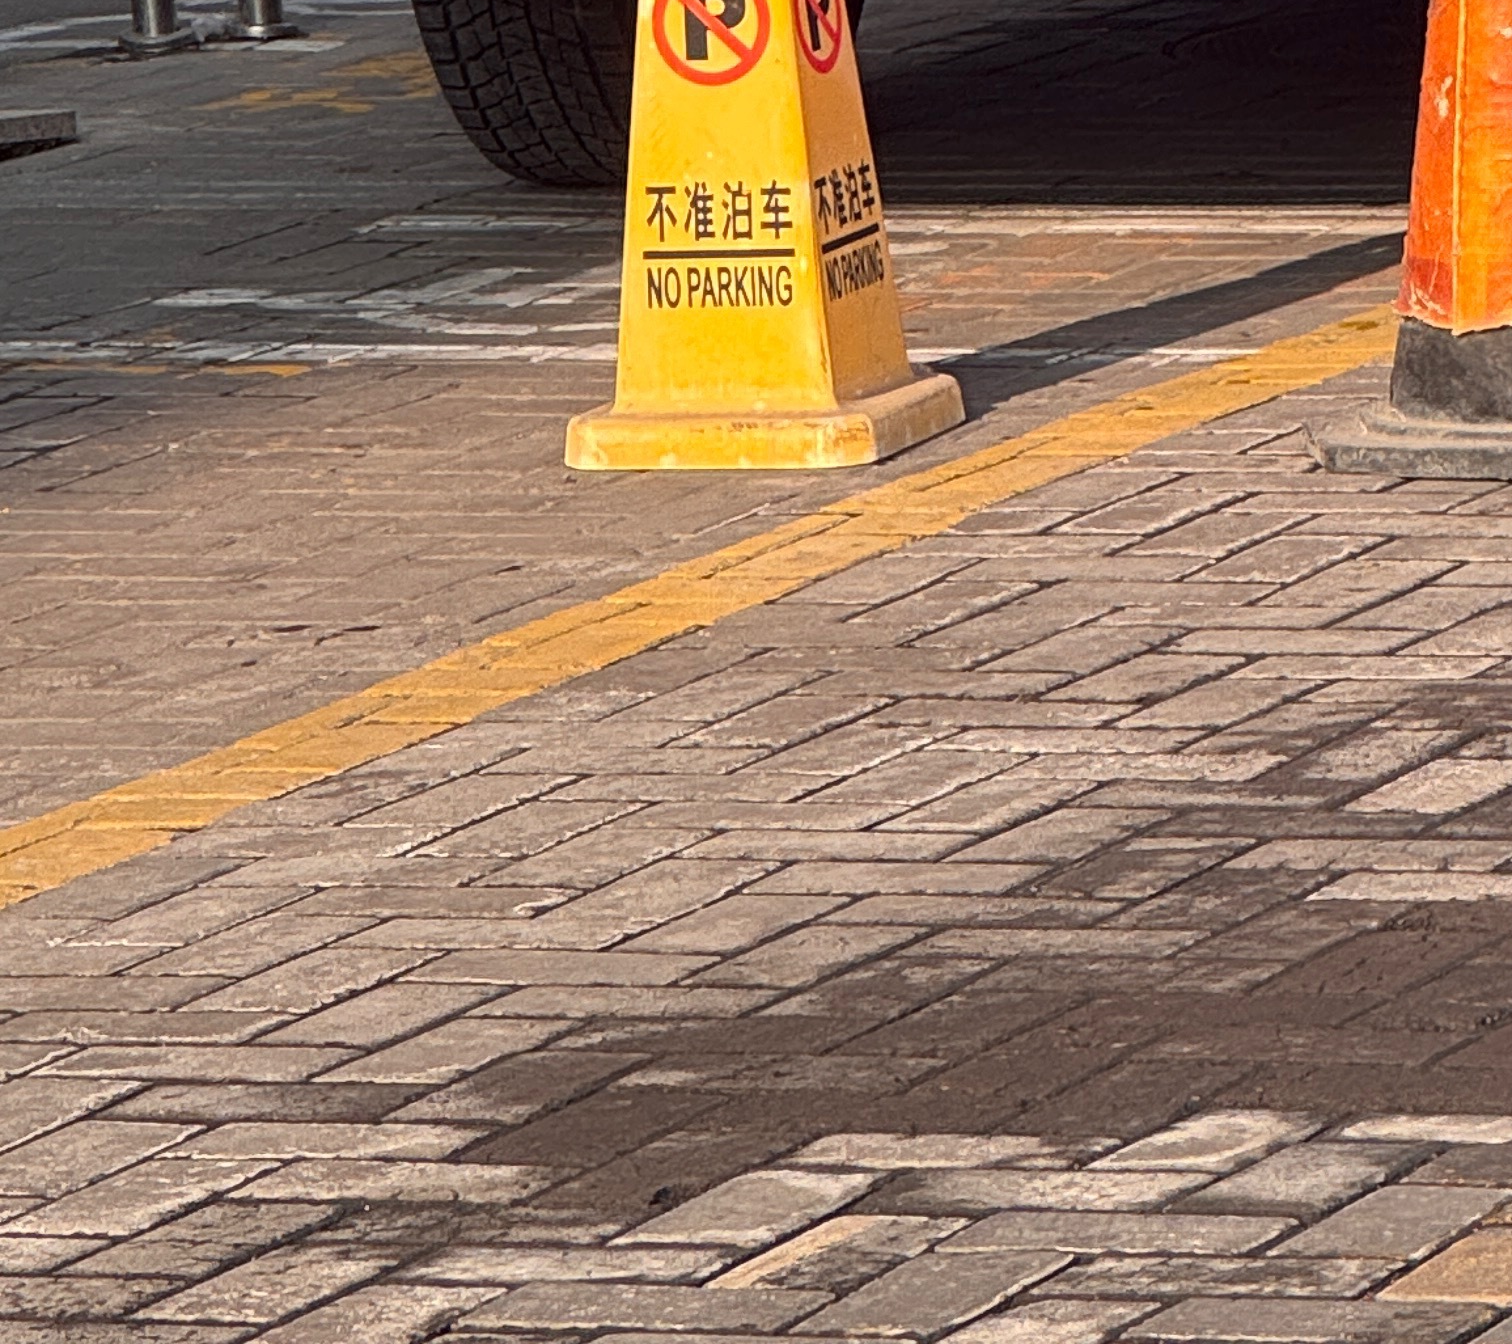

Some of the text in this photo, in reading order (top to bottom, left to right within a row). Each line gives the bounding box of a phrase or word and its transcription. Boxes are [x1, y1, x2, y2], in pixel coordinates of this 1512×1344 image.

[645, 180, 793, 243] 不准泊车
[814, 158, 876, 235] 不准泊车
[647, 264, 793, 309] NO PARKING
